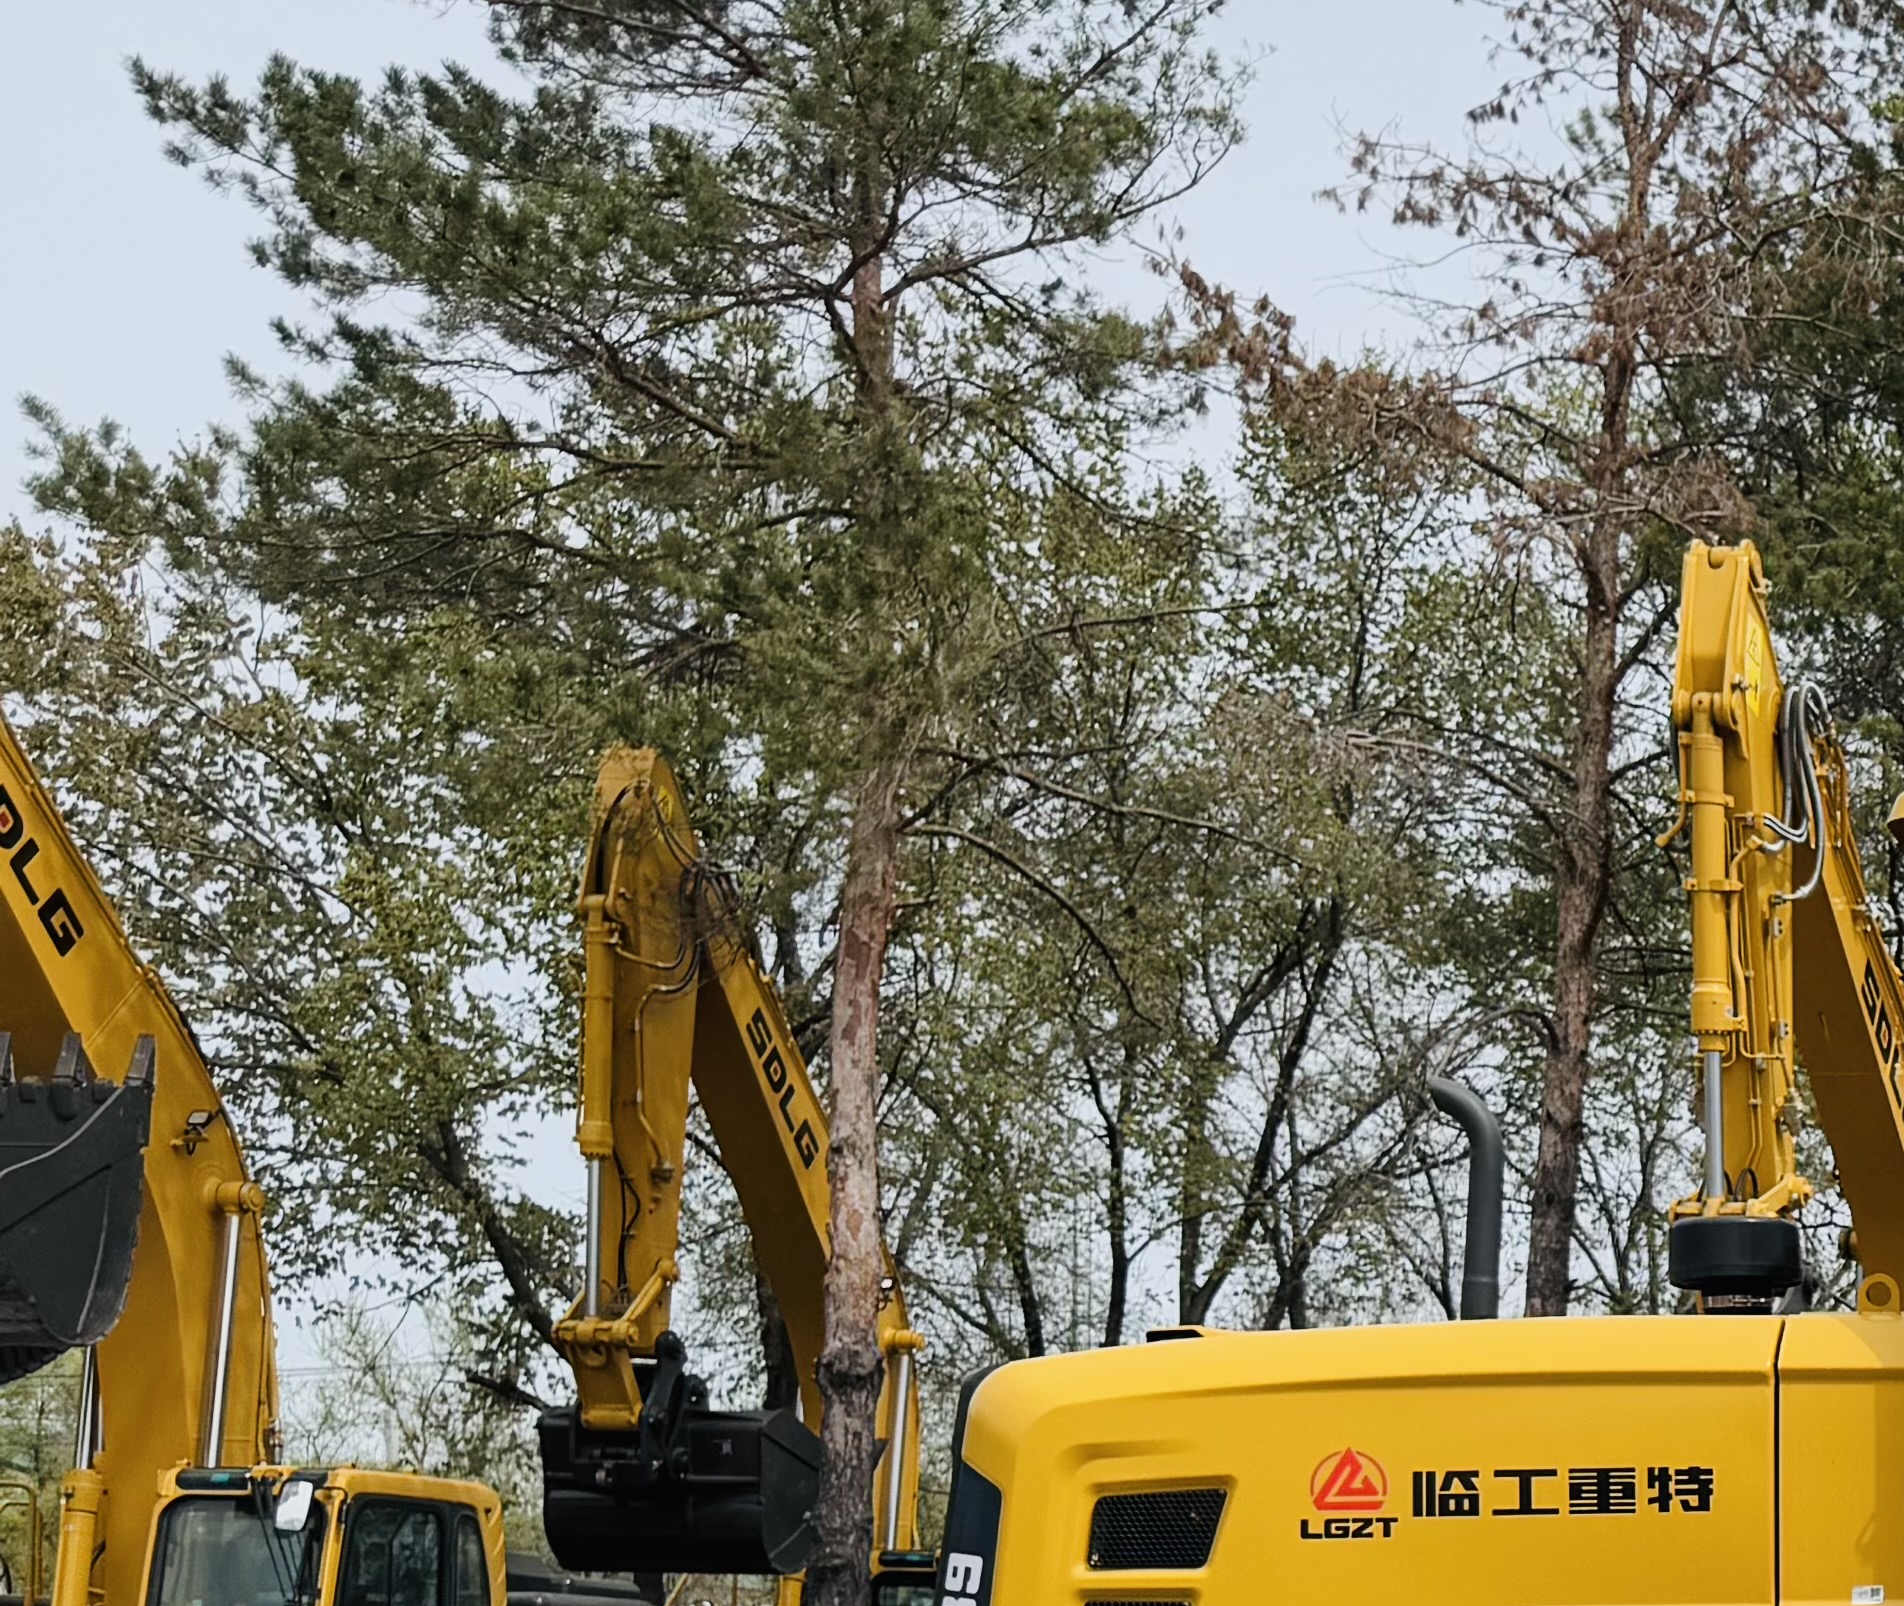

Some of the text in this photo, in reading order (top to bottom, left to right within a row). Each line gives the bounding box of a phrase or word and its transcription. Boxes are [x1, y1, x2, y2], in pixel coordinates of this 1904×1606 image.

[746, 1007, 820, 1169] SDLG
[1412, 1466, 1714, 1518] 临工重特
[1300, 1517, 1399, 1540] LGZT
